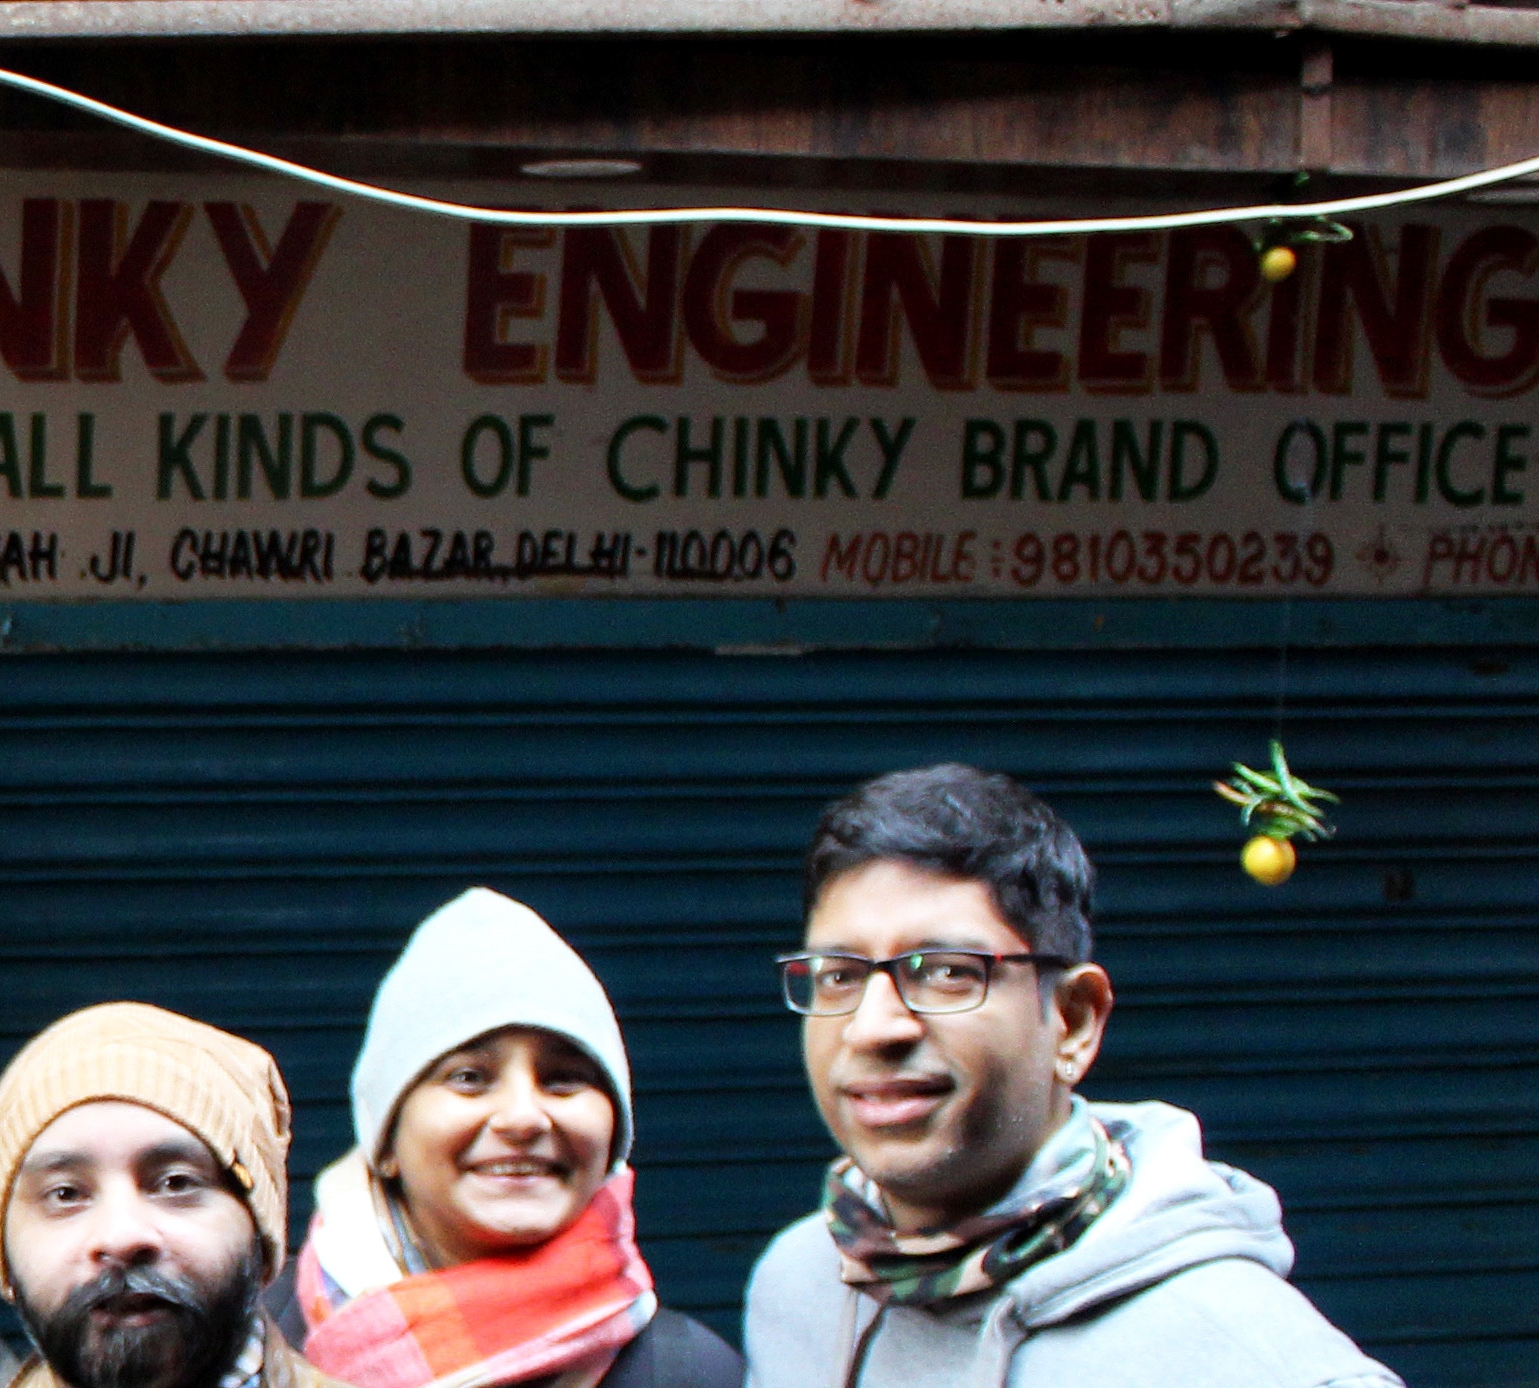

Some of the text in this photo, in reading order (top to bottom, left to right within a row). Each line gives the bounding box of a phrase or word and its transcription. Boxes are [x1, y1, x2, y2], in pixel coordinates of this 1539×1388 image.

[463, 205, 1539, 399] ENGINEERING
[155, 412, 412, 501] KINDS
[460, 413, 555, 501] OF
[605, 414, 918, 503] CHINKY
[960, 417, 1219, 502] BRAND
[1272, 418, 1531, 507] OFFICE
[170, 527, 334, 583] CHAWRI
